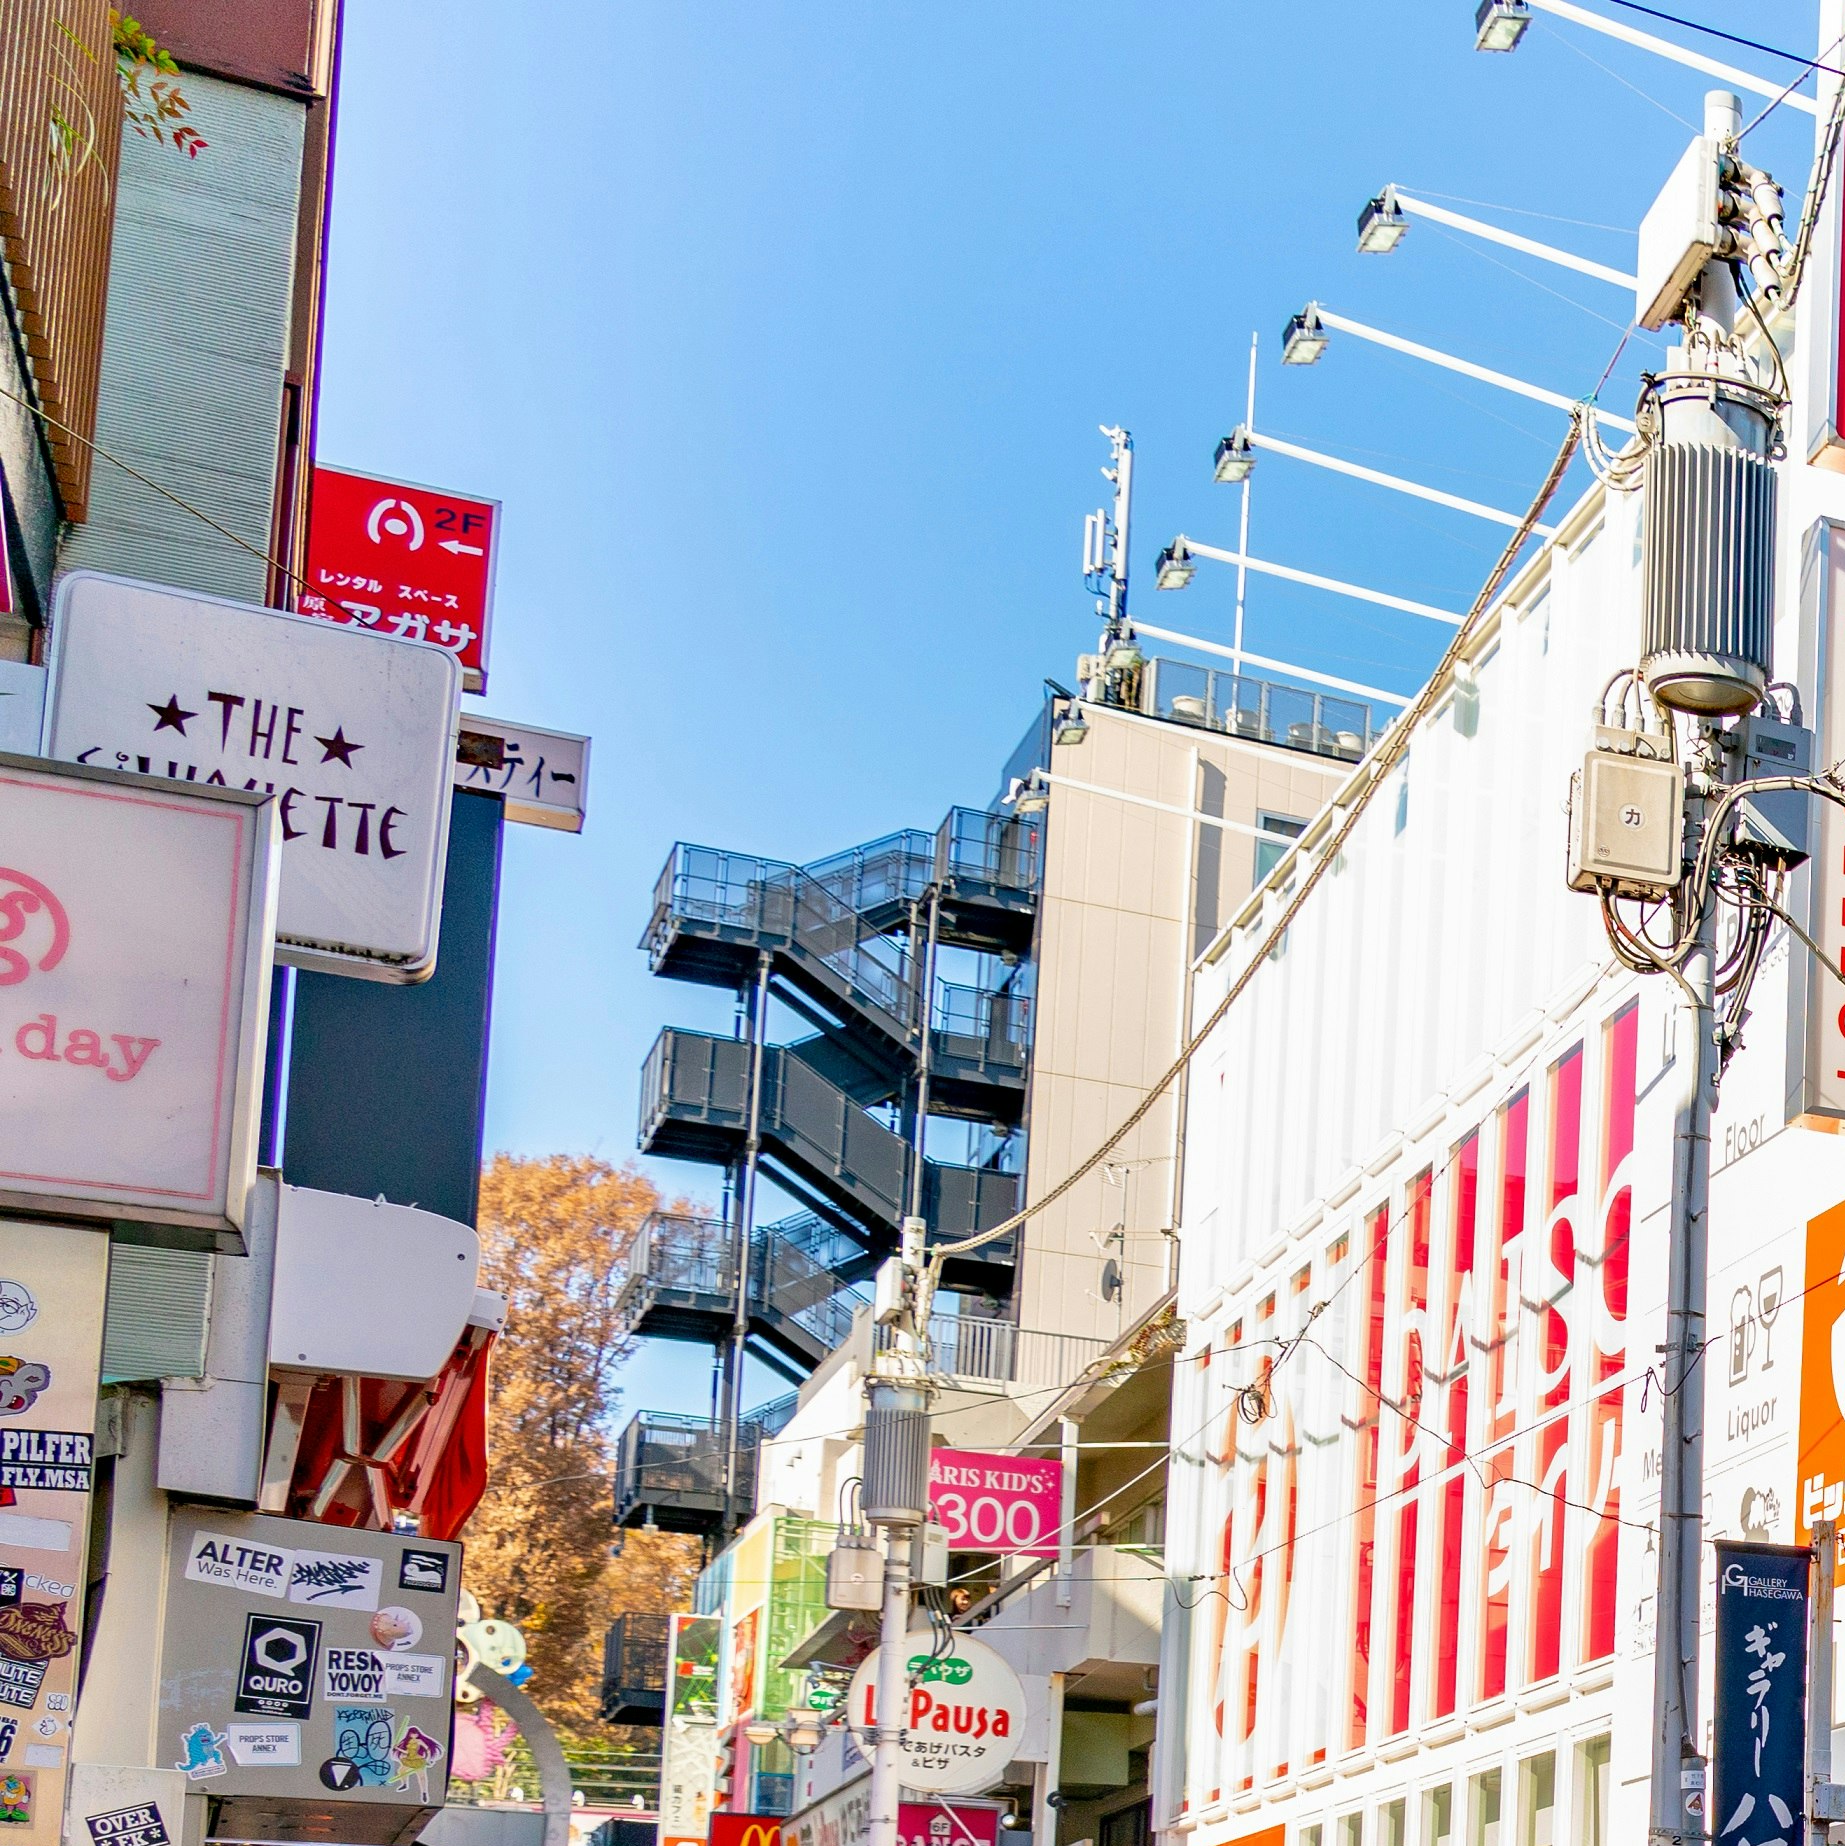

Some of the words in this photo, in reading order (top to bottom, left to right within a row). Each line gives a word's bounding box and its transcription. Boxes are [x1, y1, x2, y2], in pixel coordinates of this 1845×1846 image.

[435, 508, 486, 534] 2F
[320, 569, 383, 593] レンタル
[208, 691, 305, 766] THE
[15, 1014, 162, 1083] day
[1724, 1114, 1767, 1168] Floor
[1727, 1396, 1777, 1444] Liquor
[2, 1431, 91, 1465] PILFER
[2, 1466, 90, 1489] FLY.MSA
[985, 1467, 1044, 1496] KID'S
[196, 1540, 285, 1577] ALTER
[198, 1561, 231, 1578] Was
[236, 1569, 278, 1590] Here.
[1749, 1577, 1788, 1588] GALLERY
[1749, 1589, 1804, 1601] HASEGAWA
[250, 1676, 303, 1695] QURO
[329, 1672, 384, 1693] YOVOY
[1744, 1621, 1787, 1779] ギャラリー
[909, 1689, 1010, 1740] Pausa
[239, 1734, 264, 1743] PROPS
[265, 1734, 289, 1743] STORE
[252, 1743, 277, 1752] ANNEX
[96, 1808, 155, 1835] OVER
